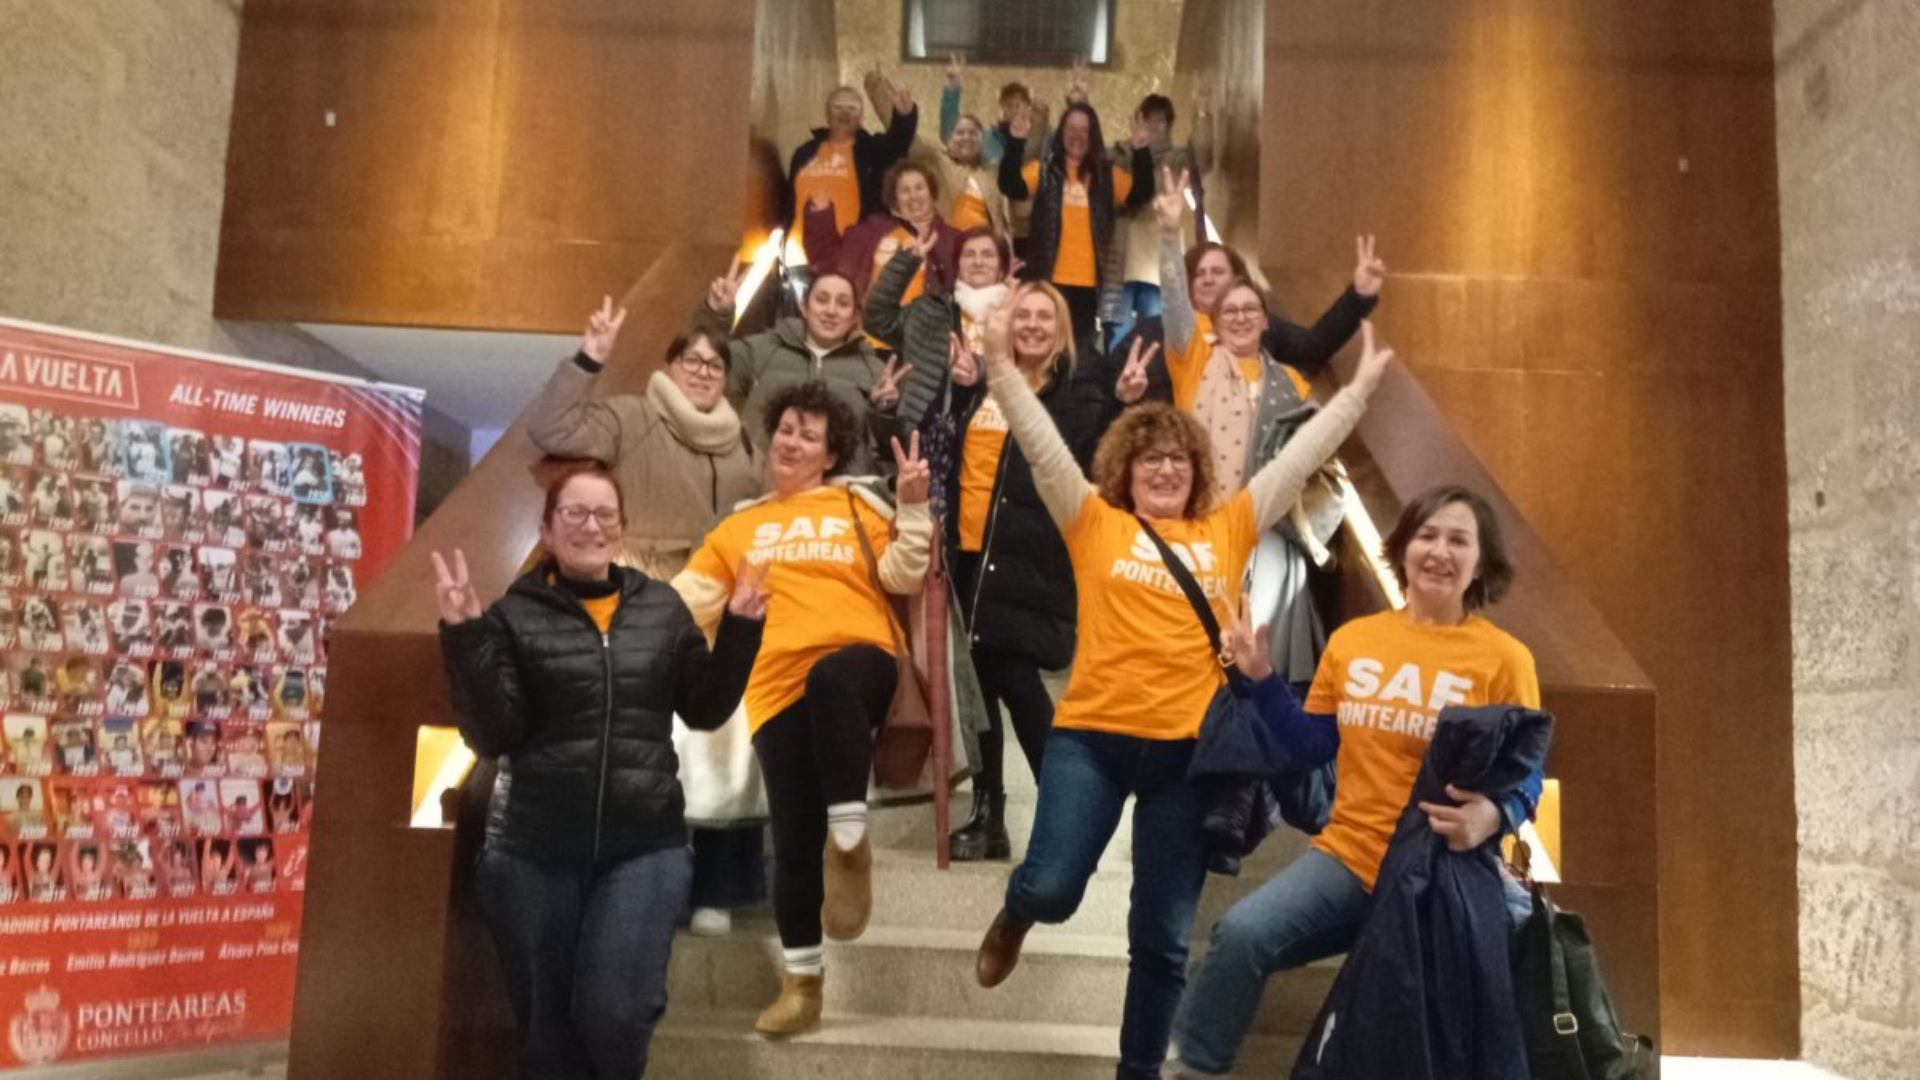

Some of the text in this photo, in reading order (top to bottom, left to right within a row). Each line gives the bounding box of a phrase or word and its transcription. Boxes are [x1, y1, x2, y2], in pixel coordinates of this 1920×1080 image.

[23, 354, 123, 398] VUELTA
[170, 383, 347, 429] ALL-TIME WINNERS
[752, 516, 850, 548] SAF
[1344, 657, 1474, 712] SAF
[1337, 701, 1439, 740] ONTEARE
[0, 915, 50, 934] ADORES
[179, 907, 219, 925] VUELTA
[221, 906, 231, 922] A
[77, 988, 247, 1030] PONTEAREAS
[77, 1024, 163, 1050] CONCELLO
